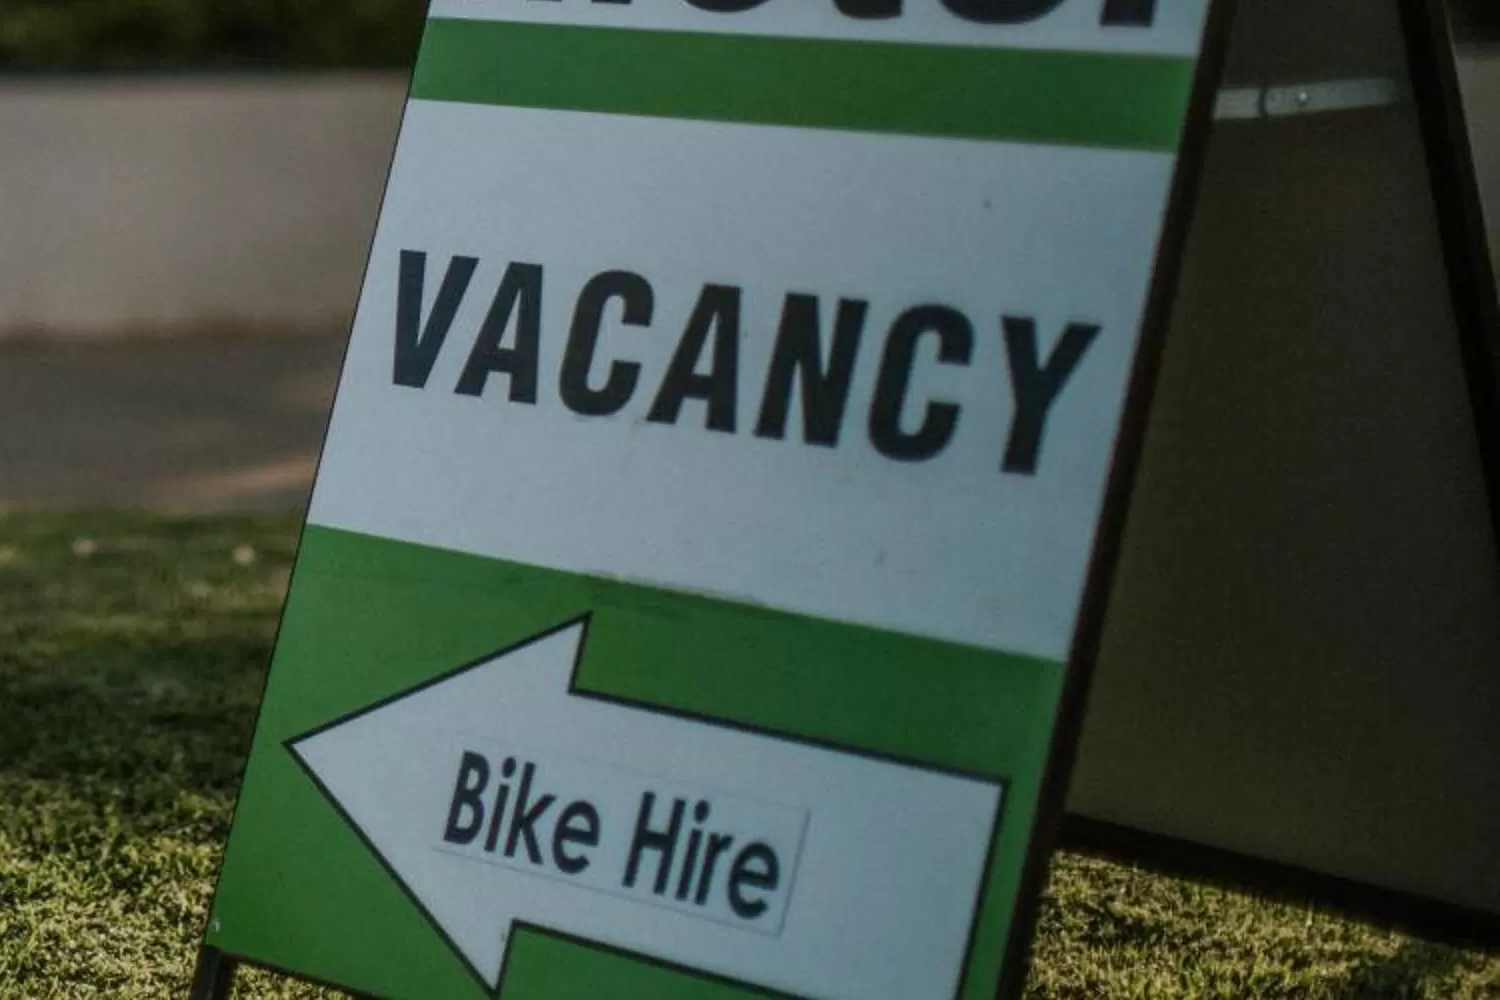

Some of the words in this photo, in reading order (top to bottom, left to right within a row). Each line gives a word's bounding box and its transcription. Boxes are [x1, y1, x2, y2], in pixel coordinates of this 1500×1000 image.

[392, 249, 1101, 476] VACANCY
[443, 751, 601, 874] Bike
[622, 791, 781, 919] Hire
